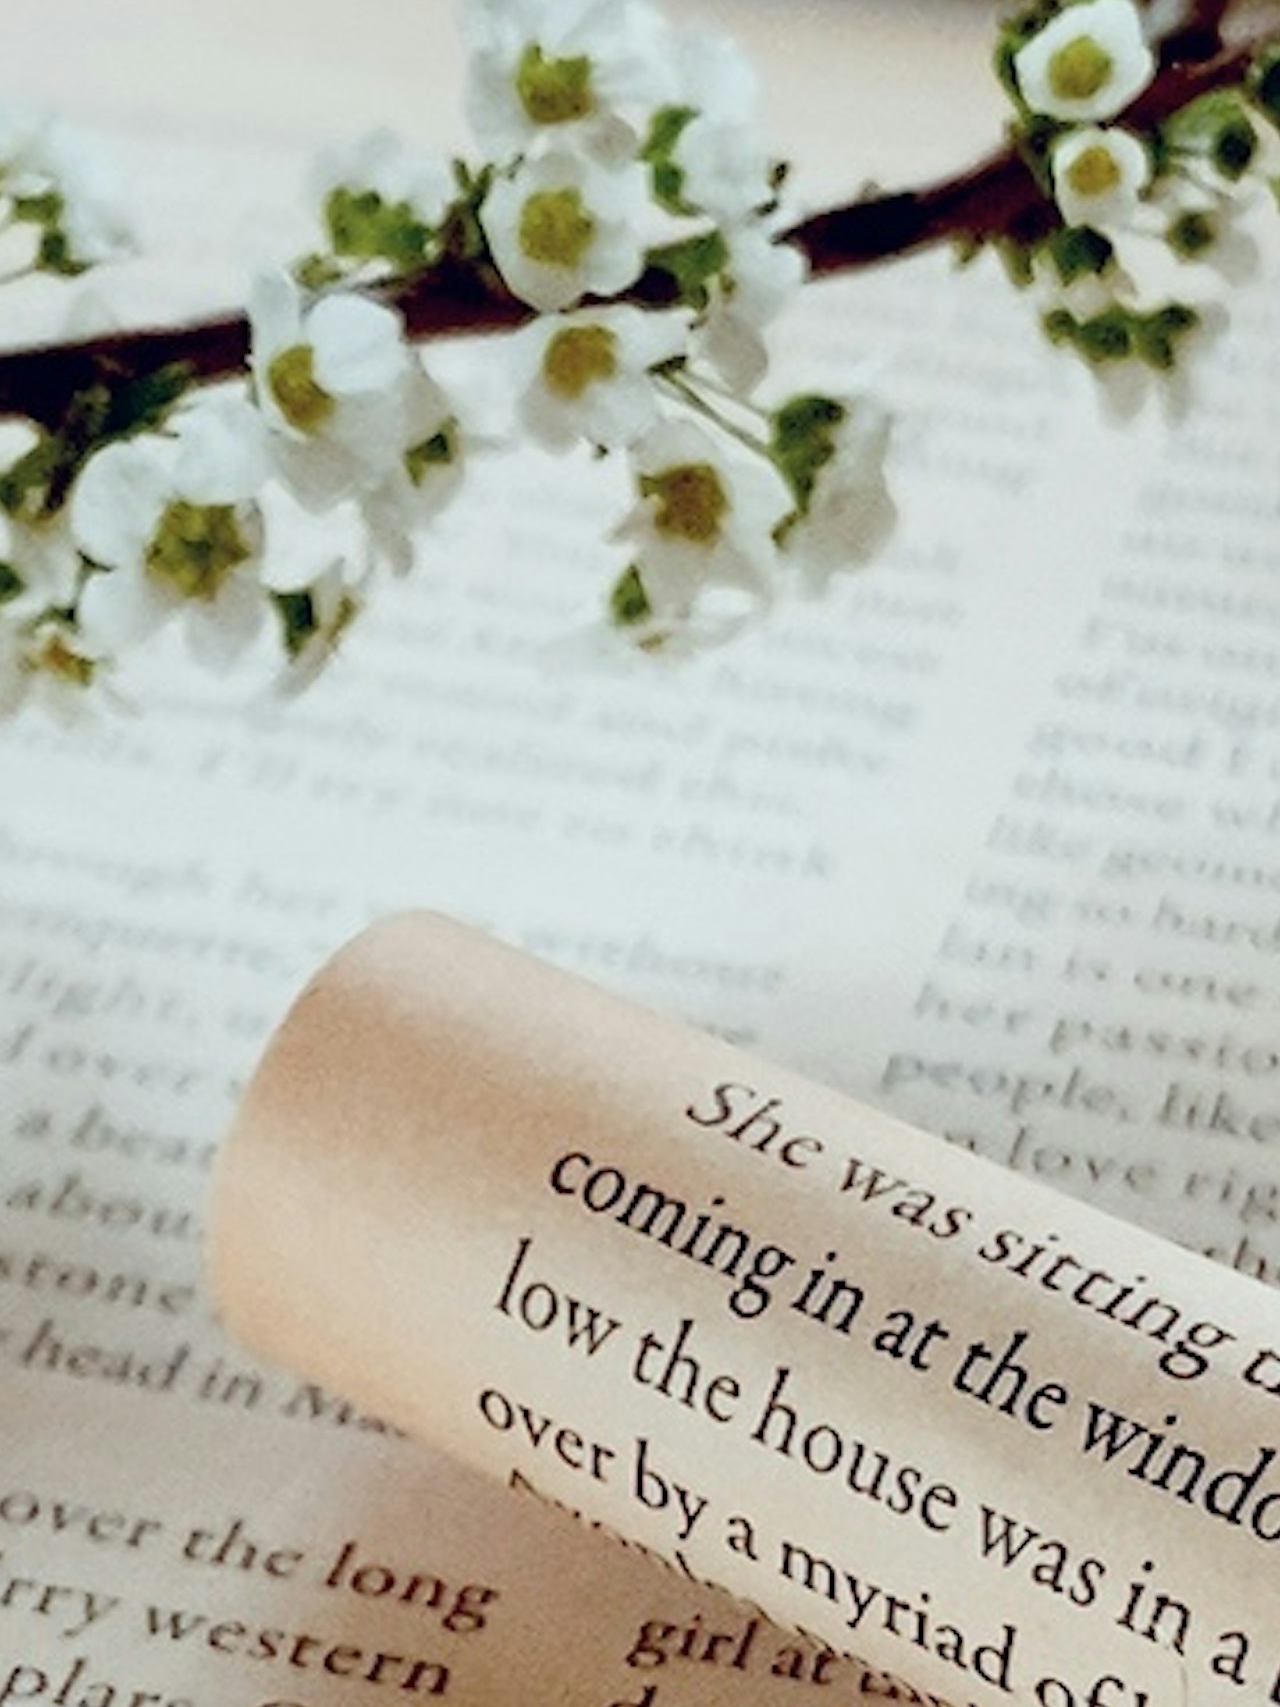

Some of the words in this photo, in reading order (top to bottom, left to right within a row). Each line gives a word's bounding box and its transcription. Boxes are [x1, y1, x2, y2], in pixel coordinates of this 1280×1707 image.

[549, 1151, 797, 1320] coming
[790, 1251, 865, 1335] in
[872, 1310, 950, 1372] at
[953, 1330, 1069, 1430] the
[685, 1084, 823, 1168] She
[841, 1159, 972, 1238] was
[978, 1232, 1234, 1381] sitting
[182, 1518, 304, 1579] the
[323, 1540, 500, 1636] long
[478, 1389, 615, 1481] over
[635, 1438, 709, 1541] by
[727, 1517, 758, 1561] a
[780, 1541, 1017, 1693] myriad
[496, 1237, 621, 1356] low
[633, 1318, 741, 1423] the
[751, 1367, 958, 1532] house
[981, 1505, 1106, 1607] was
[1116, 1560, 1191, 1656] in
[1211, 1631, 1250, 1686] a
